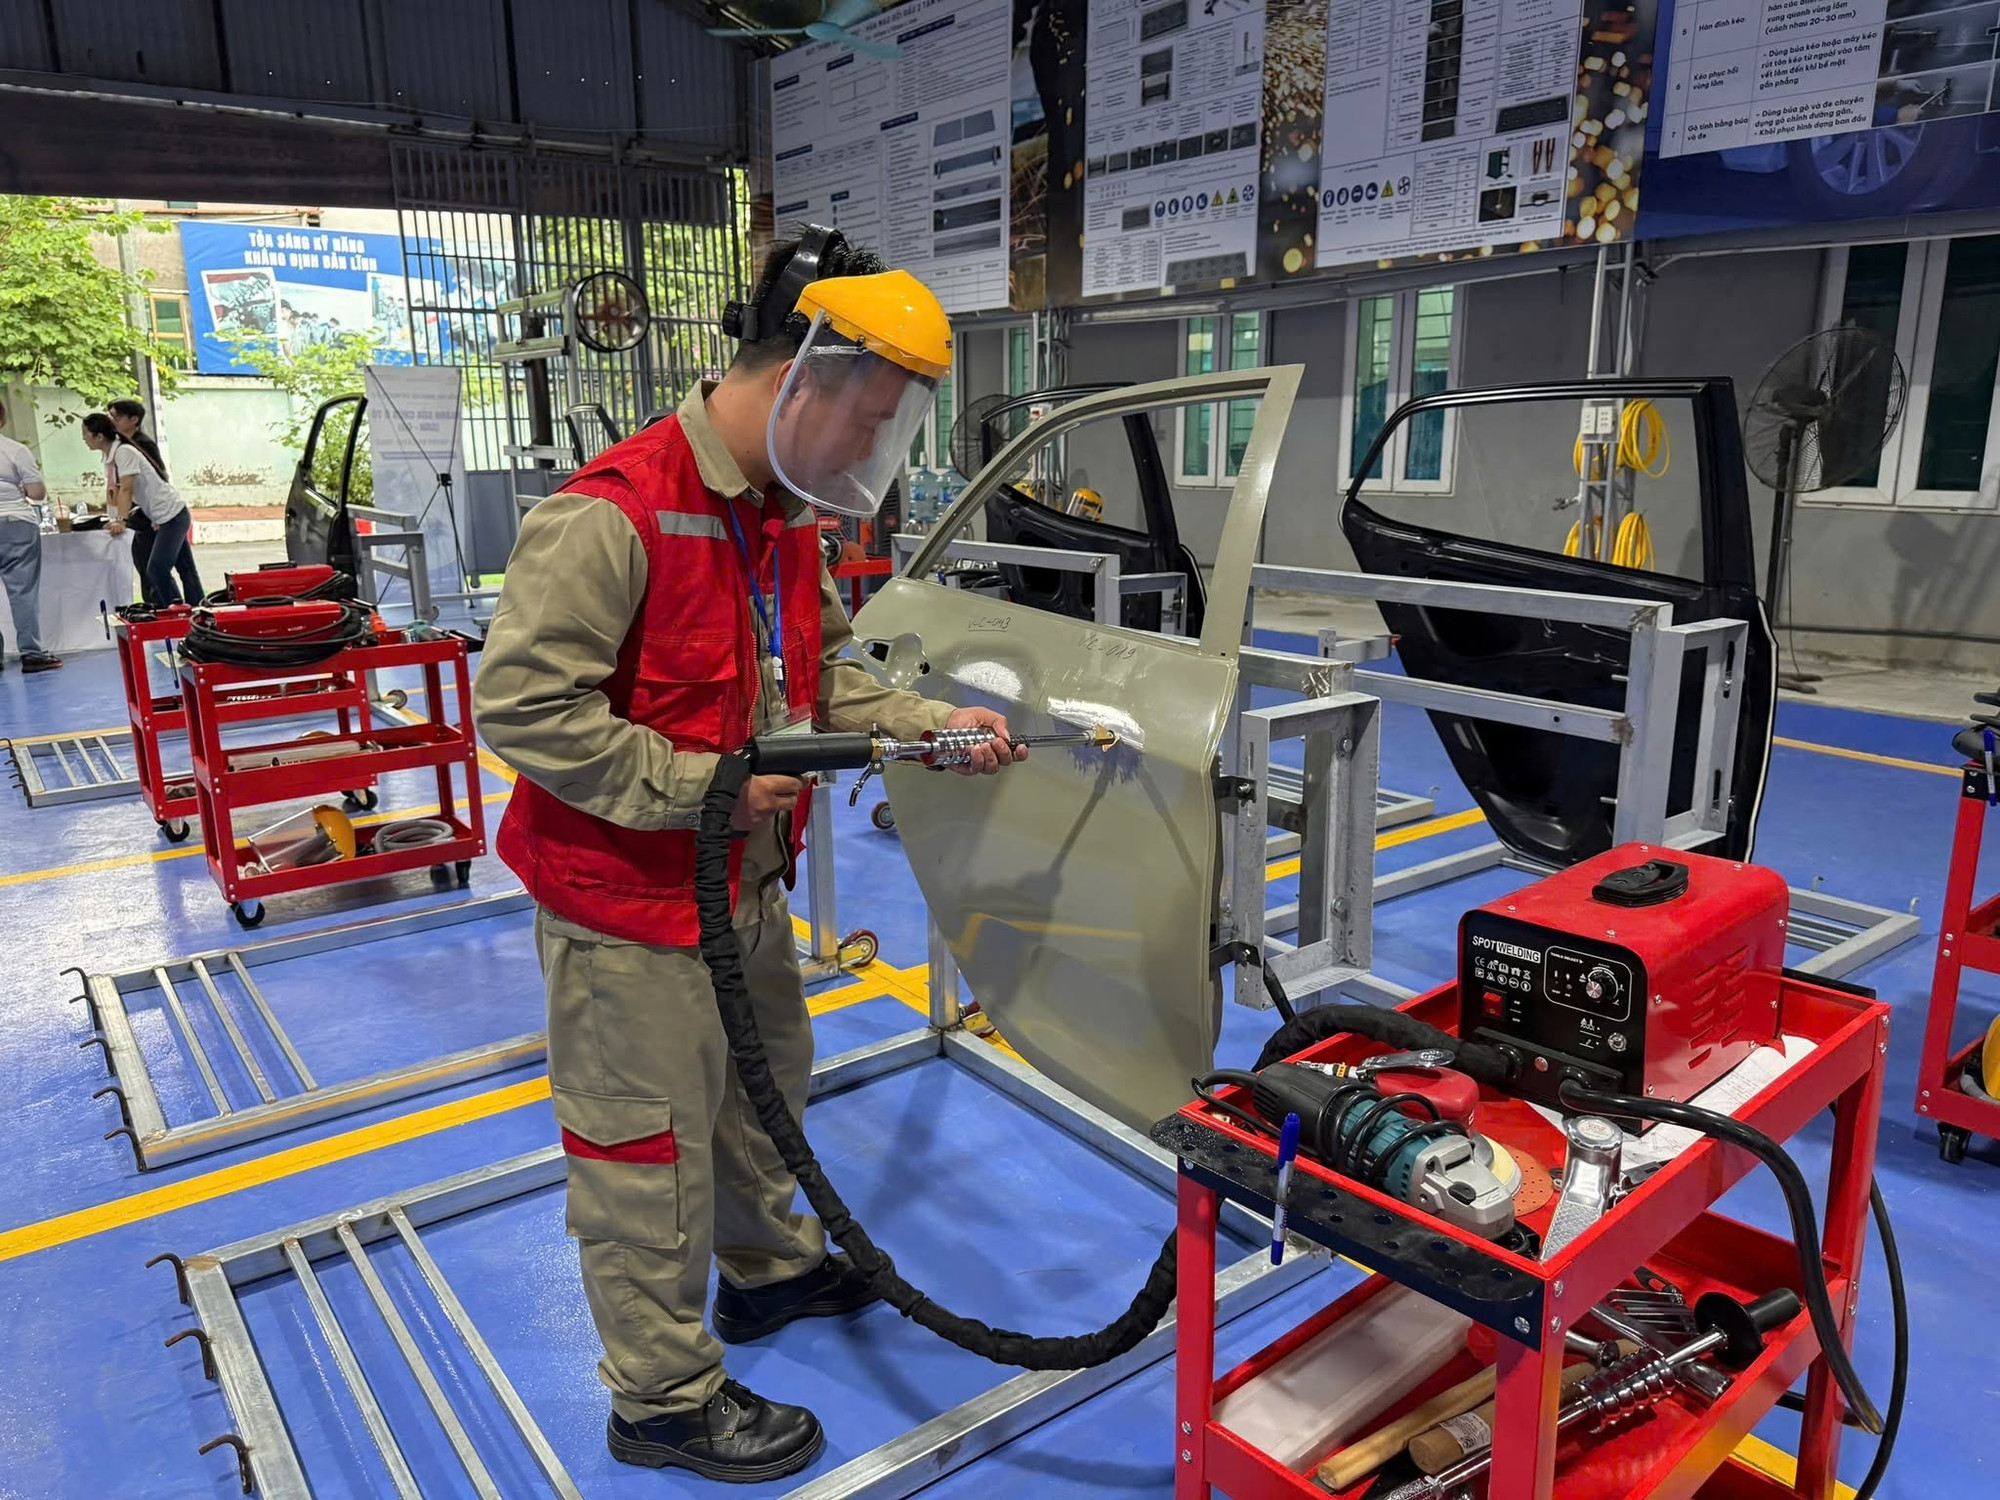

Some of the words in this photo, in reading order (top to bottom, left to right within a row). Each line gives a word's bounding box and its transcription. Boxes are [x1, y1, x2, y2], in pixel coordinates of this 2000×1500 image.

[1767, 14, 1785, 23] xung
[1787, 9, 1811, 20] quanh
[1789, 20, 1808, 29] nhau
[1810, 14, 1837, 26] 20-30
[1838, 9, 1857, 20] mm)
[1682, 28, 1687, 36] 5
[277, 232, 310, 250] SÁNG
[289, 252, 319, 270] ĐỊNH
[350, 254, 378, 271] LĨNH
